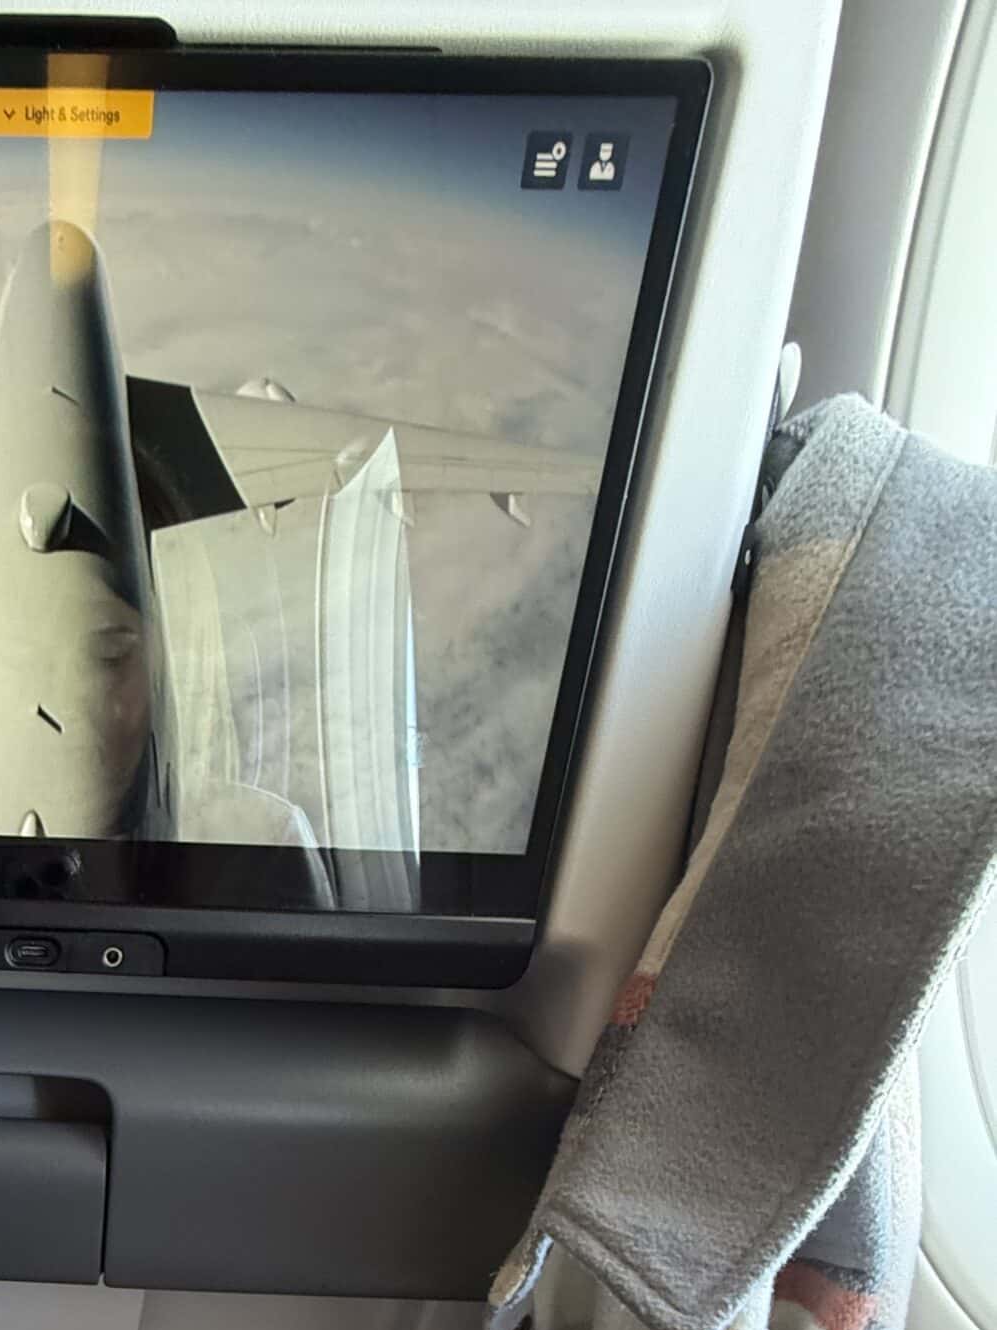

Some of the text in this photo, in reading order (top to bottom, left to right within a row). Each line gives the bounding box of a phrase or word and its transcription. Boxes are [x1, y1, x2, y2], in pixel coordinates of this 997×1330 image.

[24, 106, 121, 126] Light & Settings
